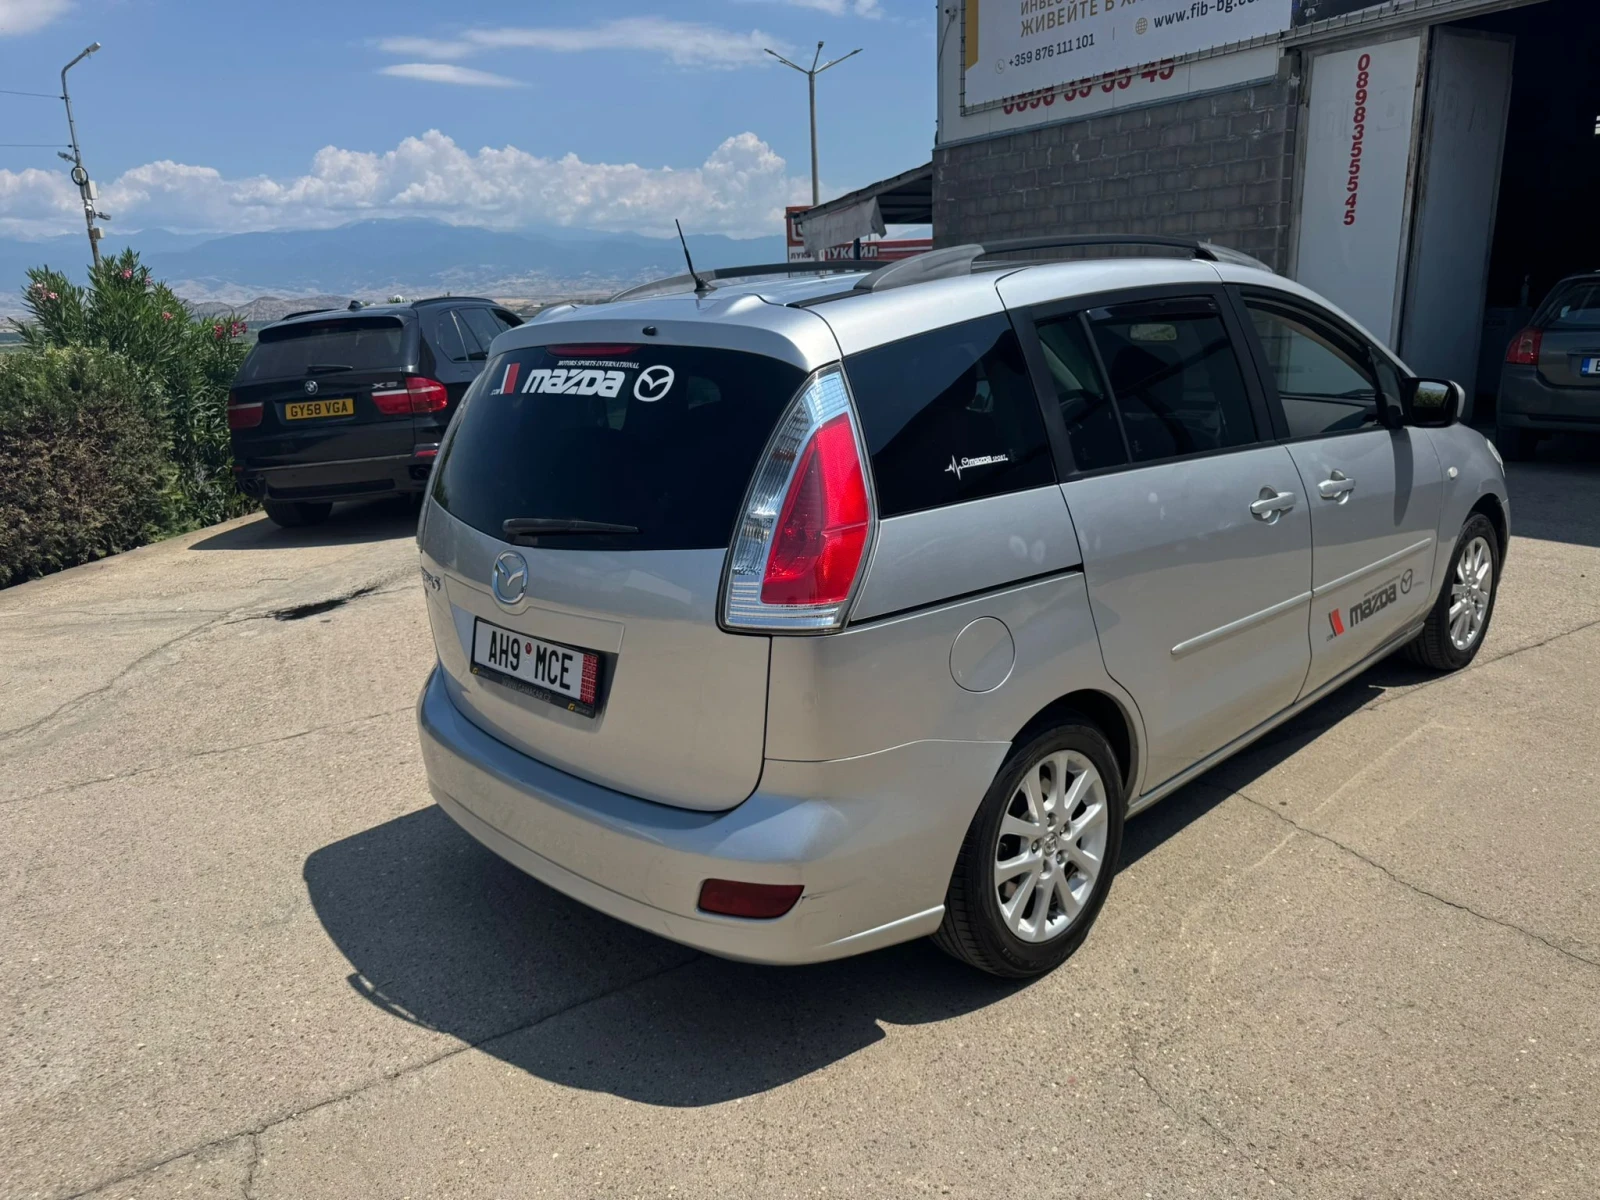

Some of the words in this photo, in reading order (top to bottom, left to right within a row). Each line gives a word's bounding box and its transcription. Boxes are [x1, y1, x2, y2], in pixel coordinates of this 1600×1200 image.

[1021, 0, 1098, 37] ЖИВЕЙТЕ
[1009, 51, 1032, 66] +359
[1035, 45, 1054, 61] 876
[1056, 40, 1073, 55] 111
[1076, 33, 1095, 49] 101
[1343, 54, 1370, 226] 0898355545
[325, 402, 348, 415] VGA
[488, 631, 521, 672] AH9
[534, 644, 573, 691] MCE
